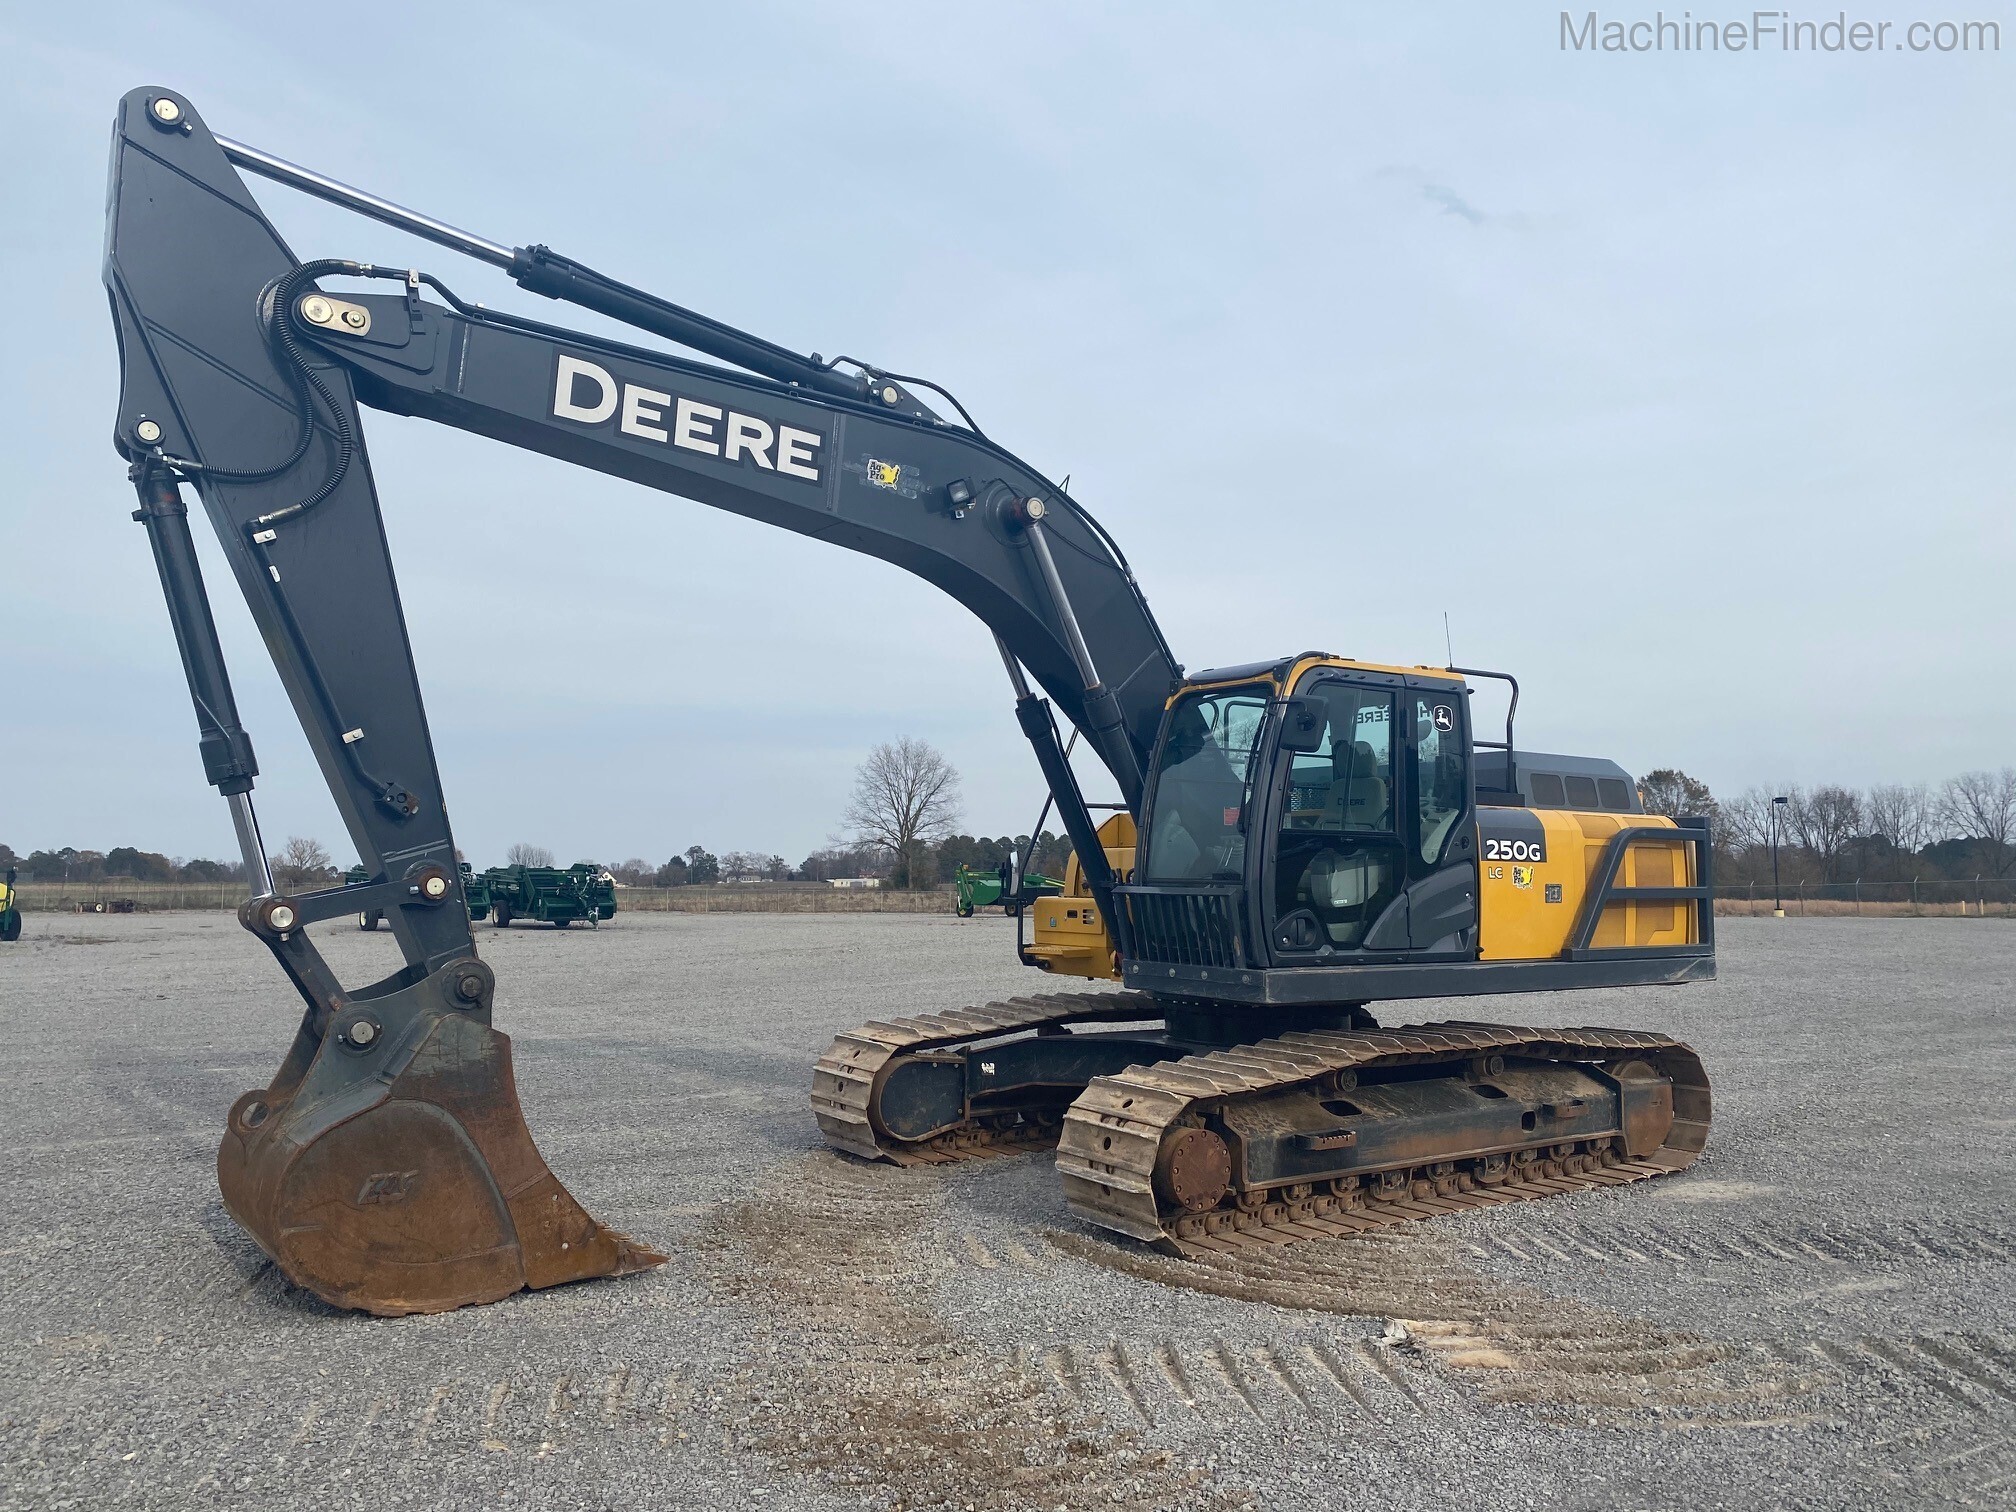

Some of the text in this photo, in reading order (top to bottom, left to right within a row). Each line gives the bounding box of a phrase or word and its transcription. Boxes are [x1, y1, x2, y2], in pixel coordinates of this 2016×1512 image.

[553, 354, 821, 481] DEERE
[869, 461, 882, 474] Ag
[869, 470, 885, 481] Pro
[1486, 839, 1541, 862] 250G
[1488, 867, 1503, 879] LC
